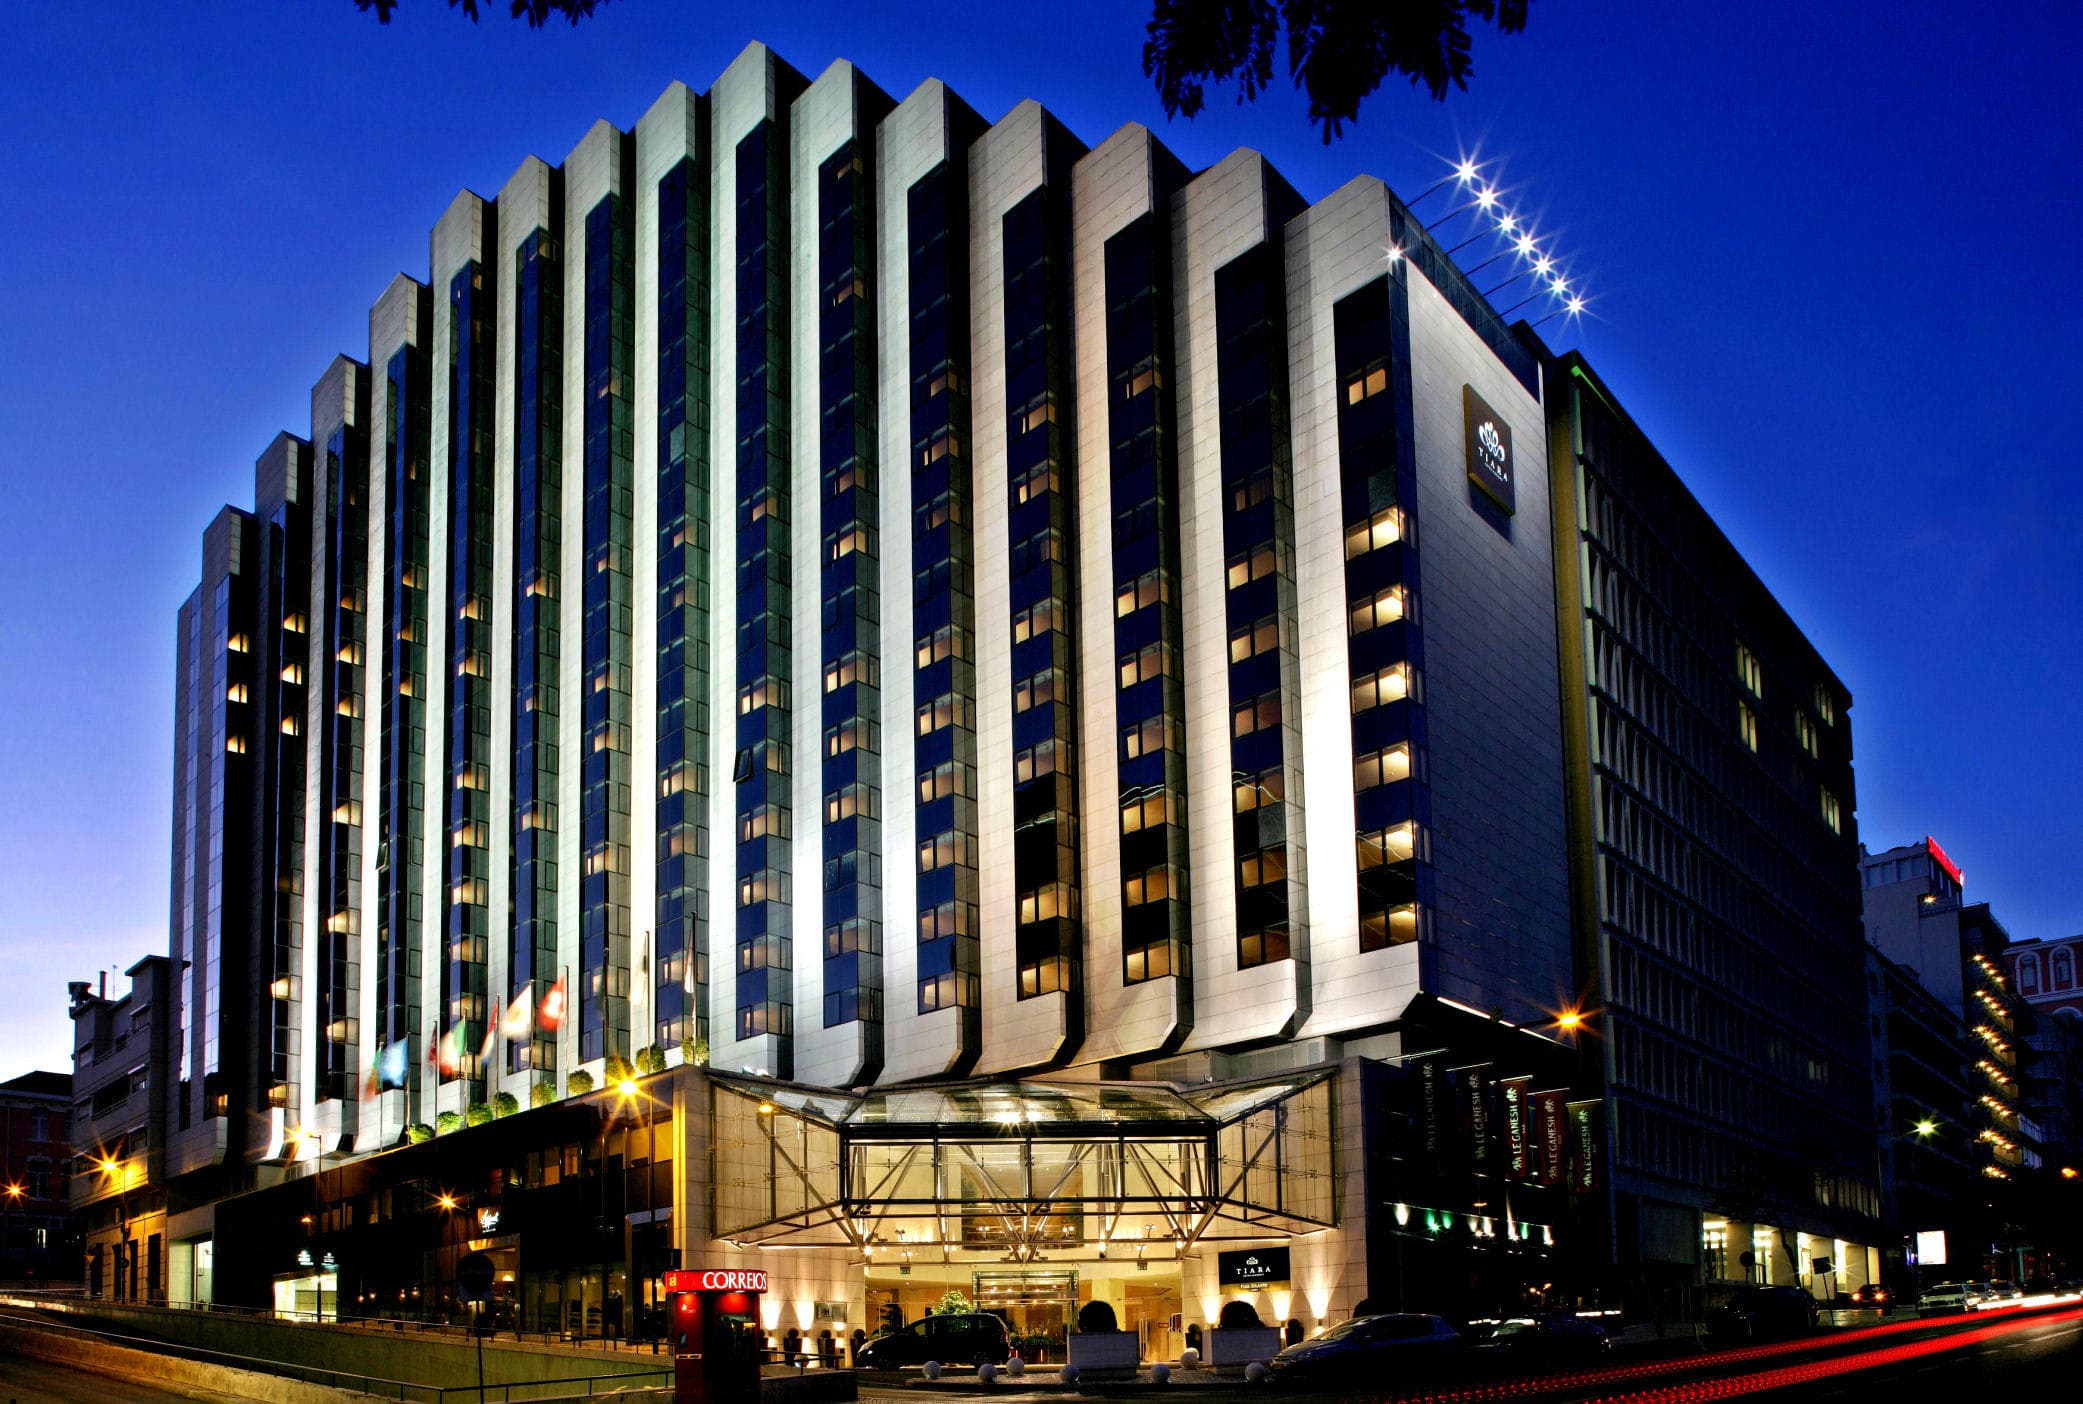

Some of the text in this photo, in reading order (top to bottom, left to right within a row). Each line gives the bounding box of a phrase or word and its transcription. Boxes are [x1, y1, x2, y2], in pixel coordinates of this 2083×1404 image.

[1479, 446, 1508, 482] TIARA
[1509, 1105, 1522, 1154] LE GANESH
[1547, 1116, 1558, 1163] LE GANESH
[1581, 1125, 1592, 1171] LE GANESH
[702, 1271, 767, 1290] CORREIOS
[1236, 1266, 1271, 1274] TIARA
